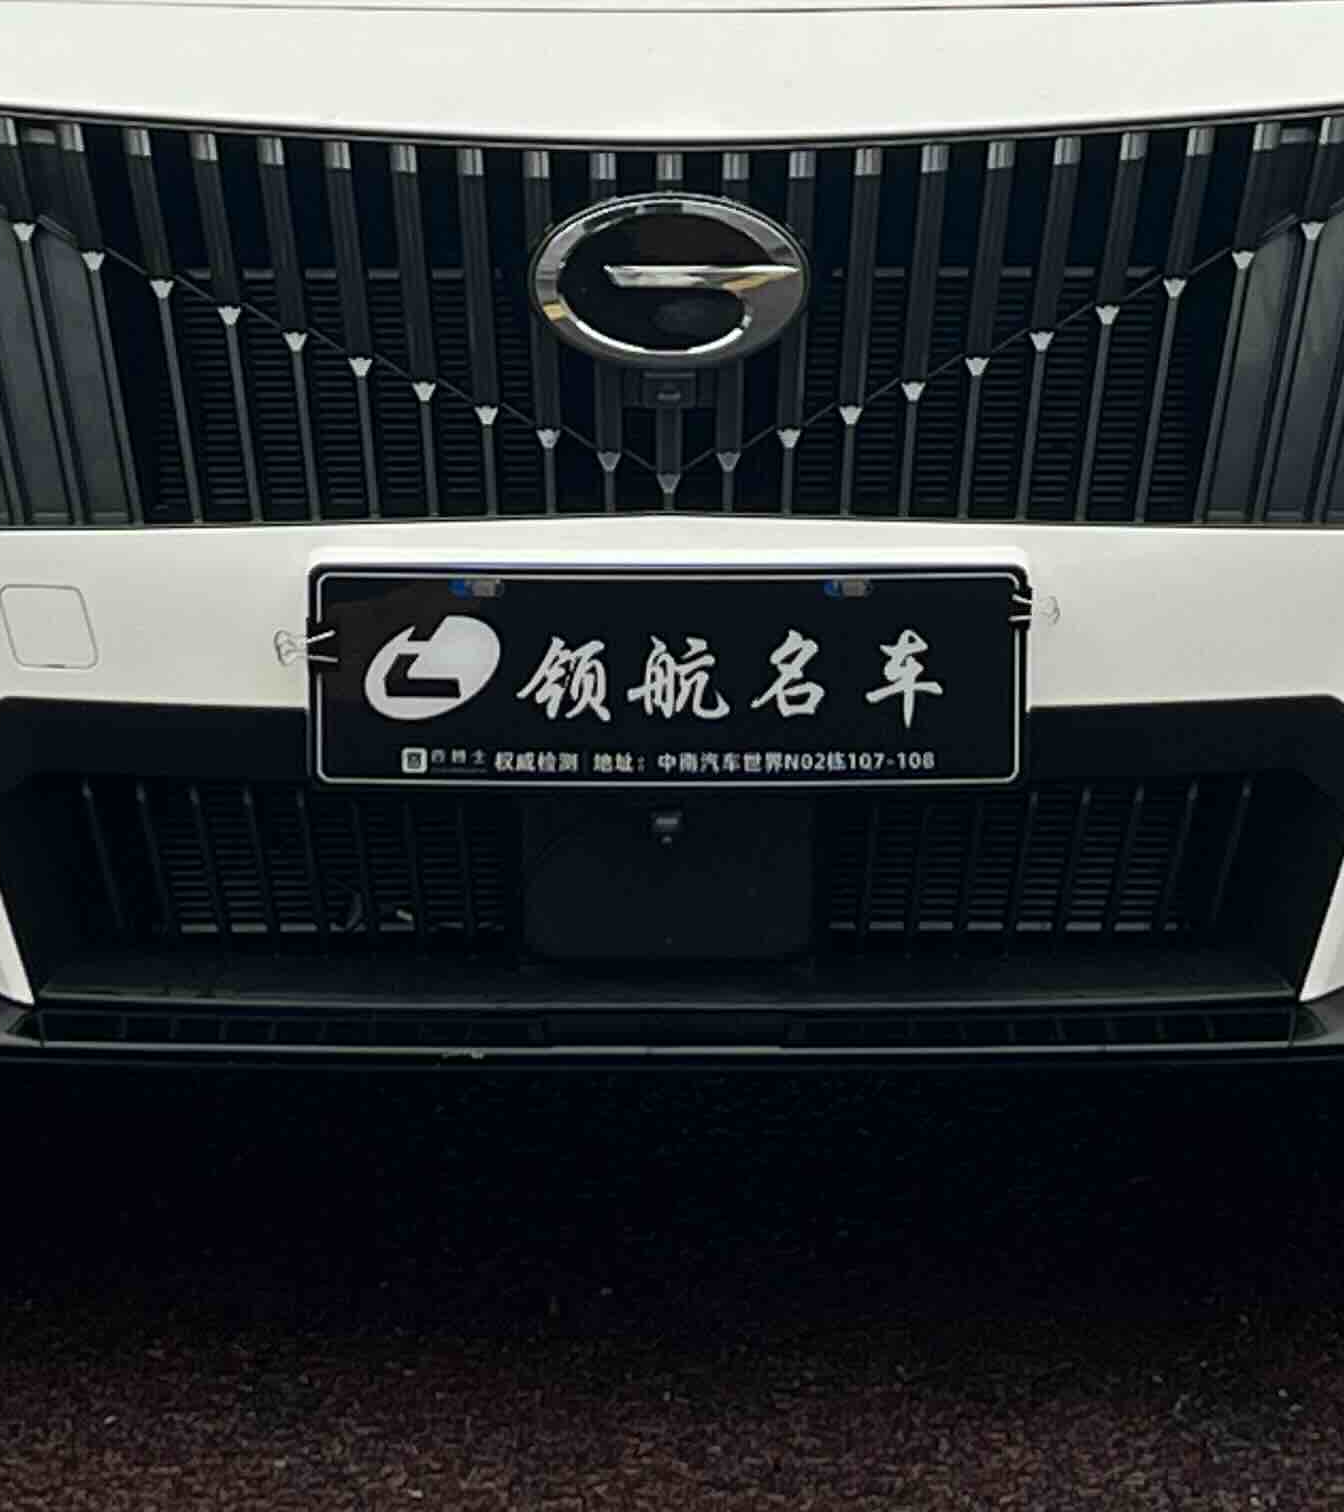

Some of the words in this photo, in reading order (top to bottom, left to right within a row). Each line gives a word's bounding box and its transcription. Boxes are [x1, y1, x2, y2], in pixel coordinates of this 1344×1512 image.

[516, 628, 944, 728] 领航名车
[495, 751, 579, 773] 权威检测
